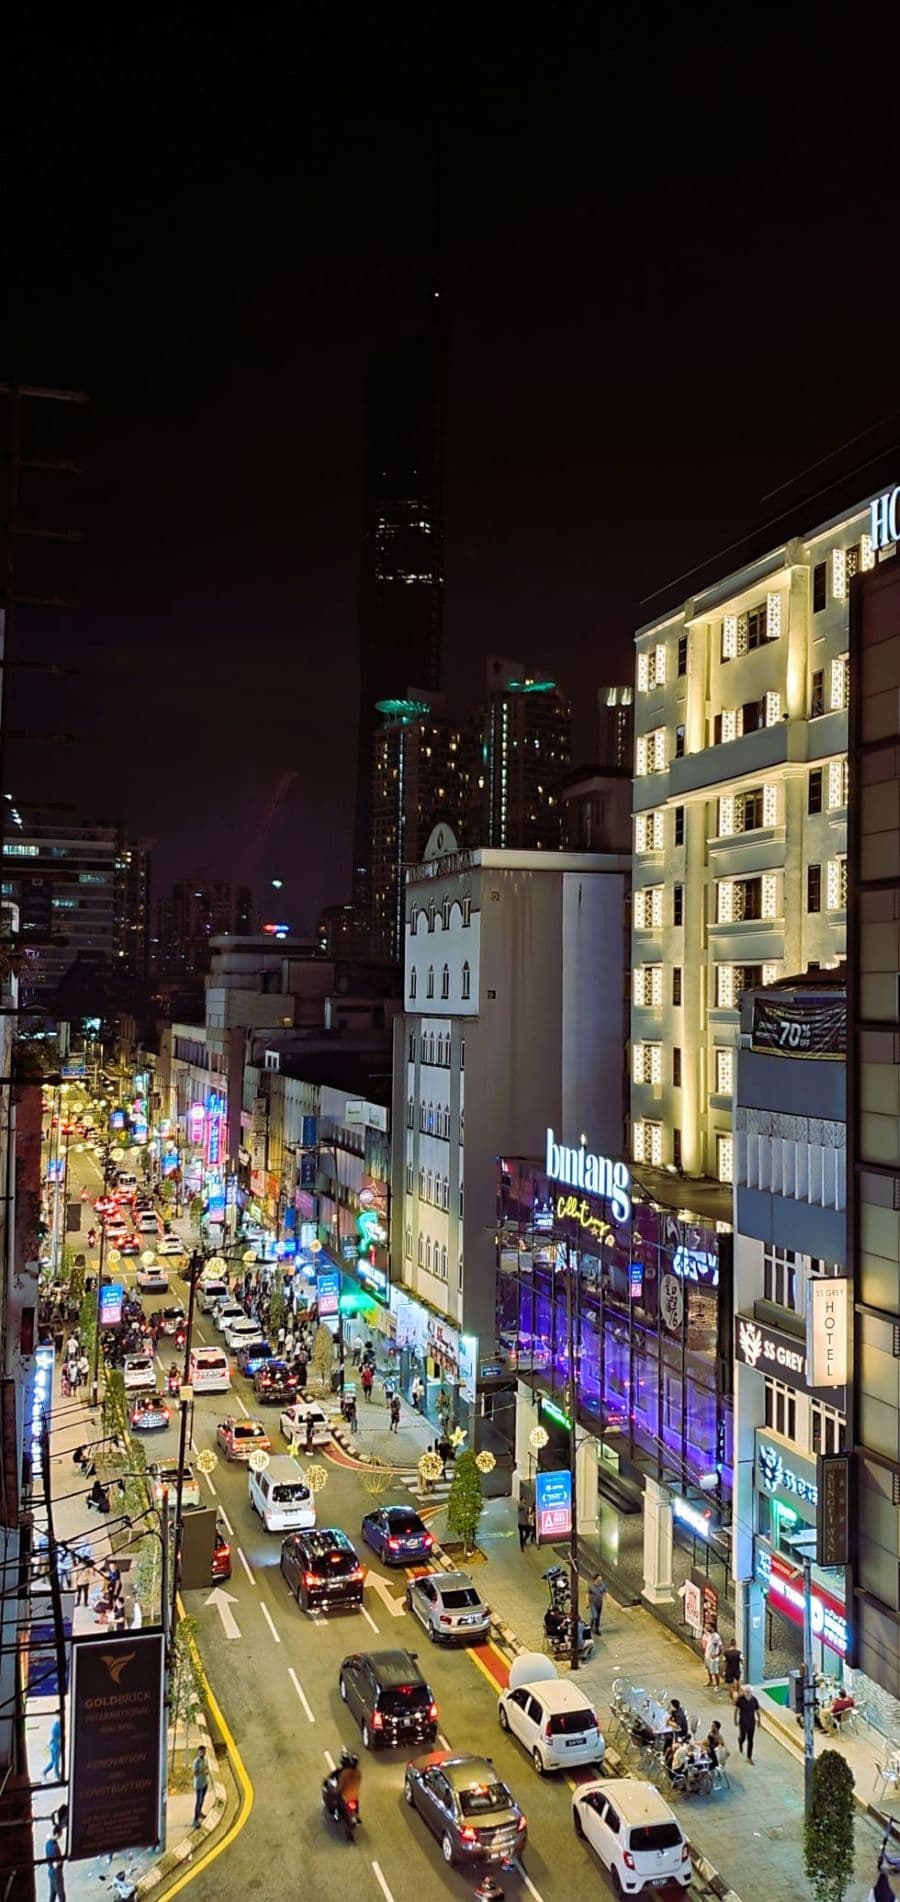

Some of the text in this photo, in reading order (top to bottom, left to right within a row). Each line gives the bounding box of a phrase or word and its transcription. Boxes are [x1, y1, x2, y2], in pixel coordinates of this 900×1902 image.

[546, 1127, 630, 1221] bintang
[816, 1289, 843, 1297] SS GREY
[824, 1301, 835, 1377] HOTEL
[763, 1340, 775, 1360] SS
[777, 1346, 803, 1373] GREY
[84, 1690, 151, 1709] GOLDBRICK
